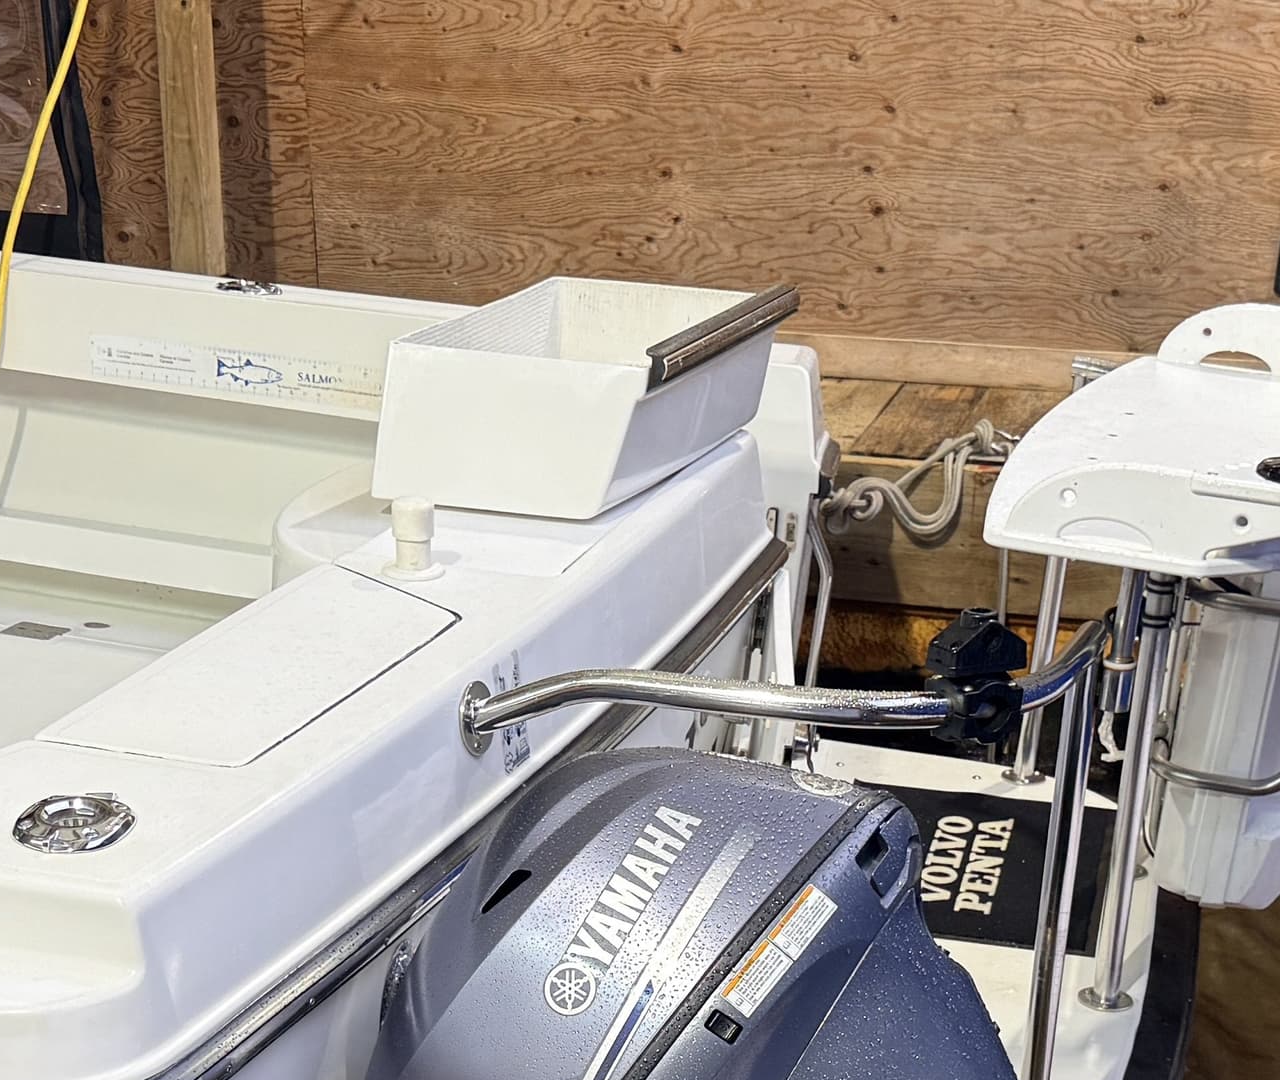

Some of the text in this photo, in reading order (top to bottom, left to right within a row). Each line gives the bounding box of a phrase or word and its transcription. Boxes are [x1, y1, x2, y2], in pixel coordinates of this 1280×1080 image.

[570, 805, 703, 969] YAMAHA
[920, 815, 974, 902] VOLVO
[953, 818, 1015, 915] PENTA
